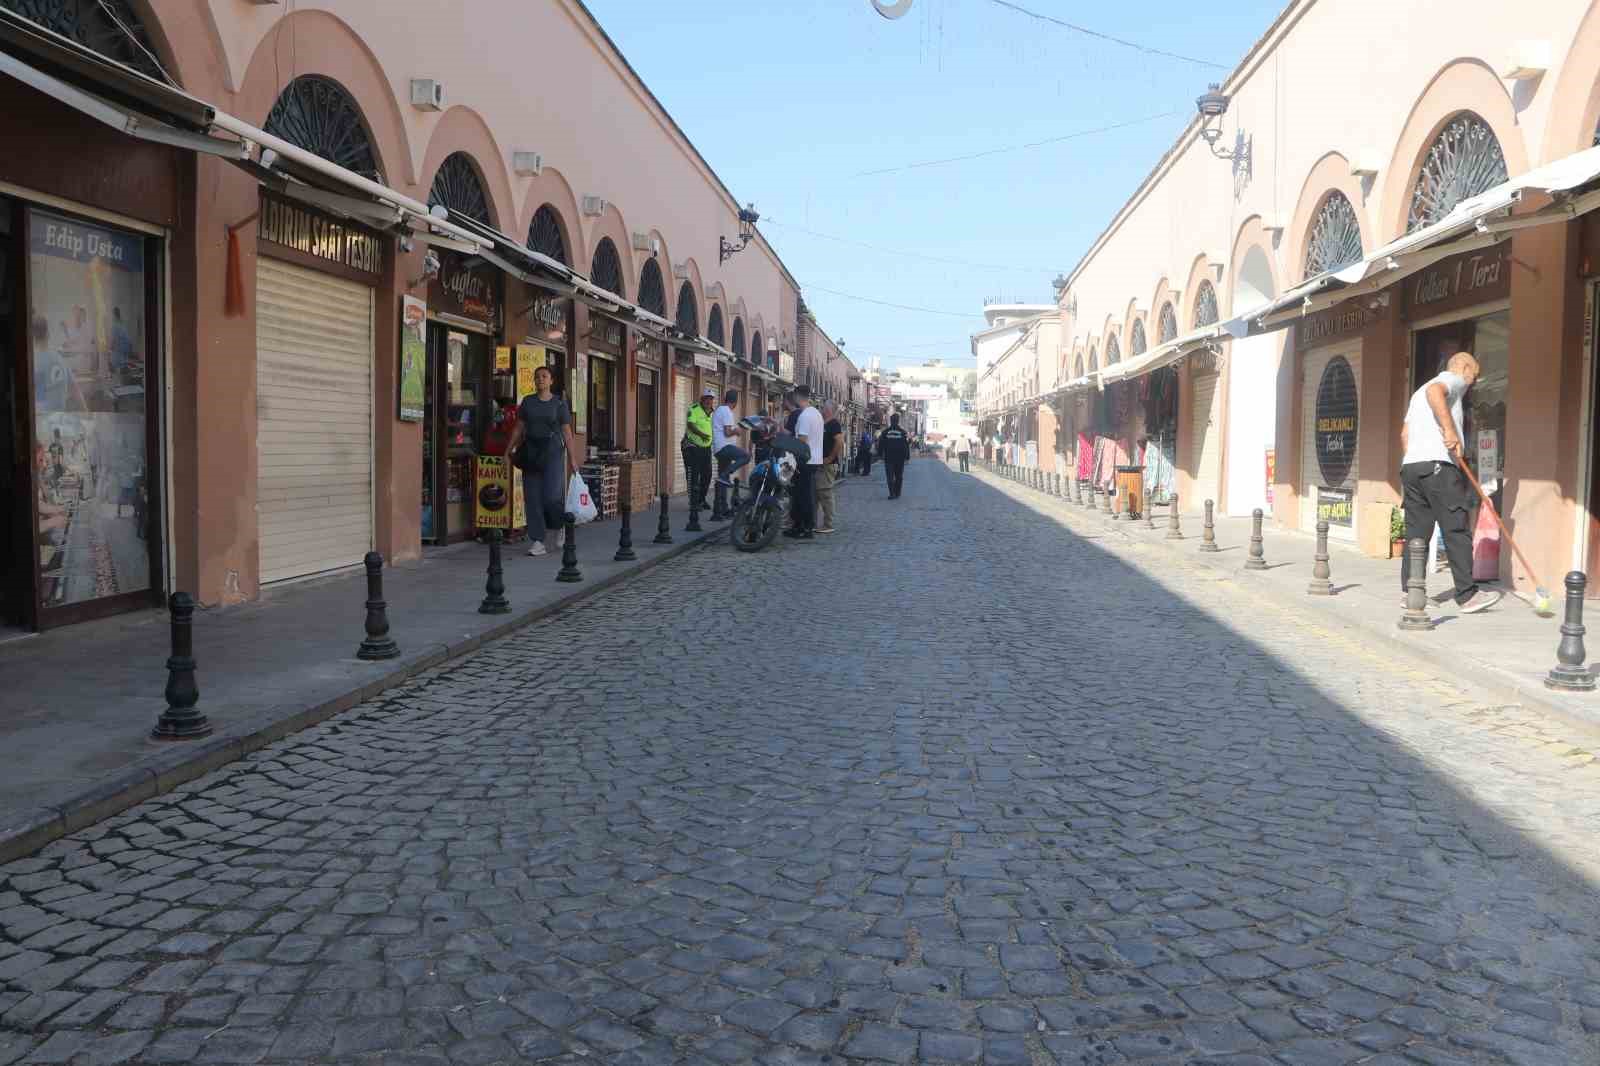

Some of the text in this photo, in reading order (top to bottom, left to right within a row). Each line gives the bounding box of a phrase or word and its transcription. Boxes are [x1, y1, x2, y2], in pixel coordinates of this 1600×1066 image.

[256, 196, 310, 253] ILDIRIM
[45, 224, 123, 261] Edip Usta
[479, 466, 509, 480] KAHVE
[480, 456, 506, 465] TAZ
